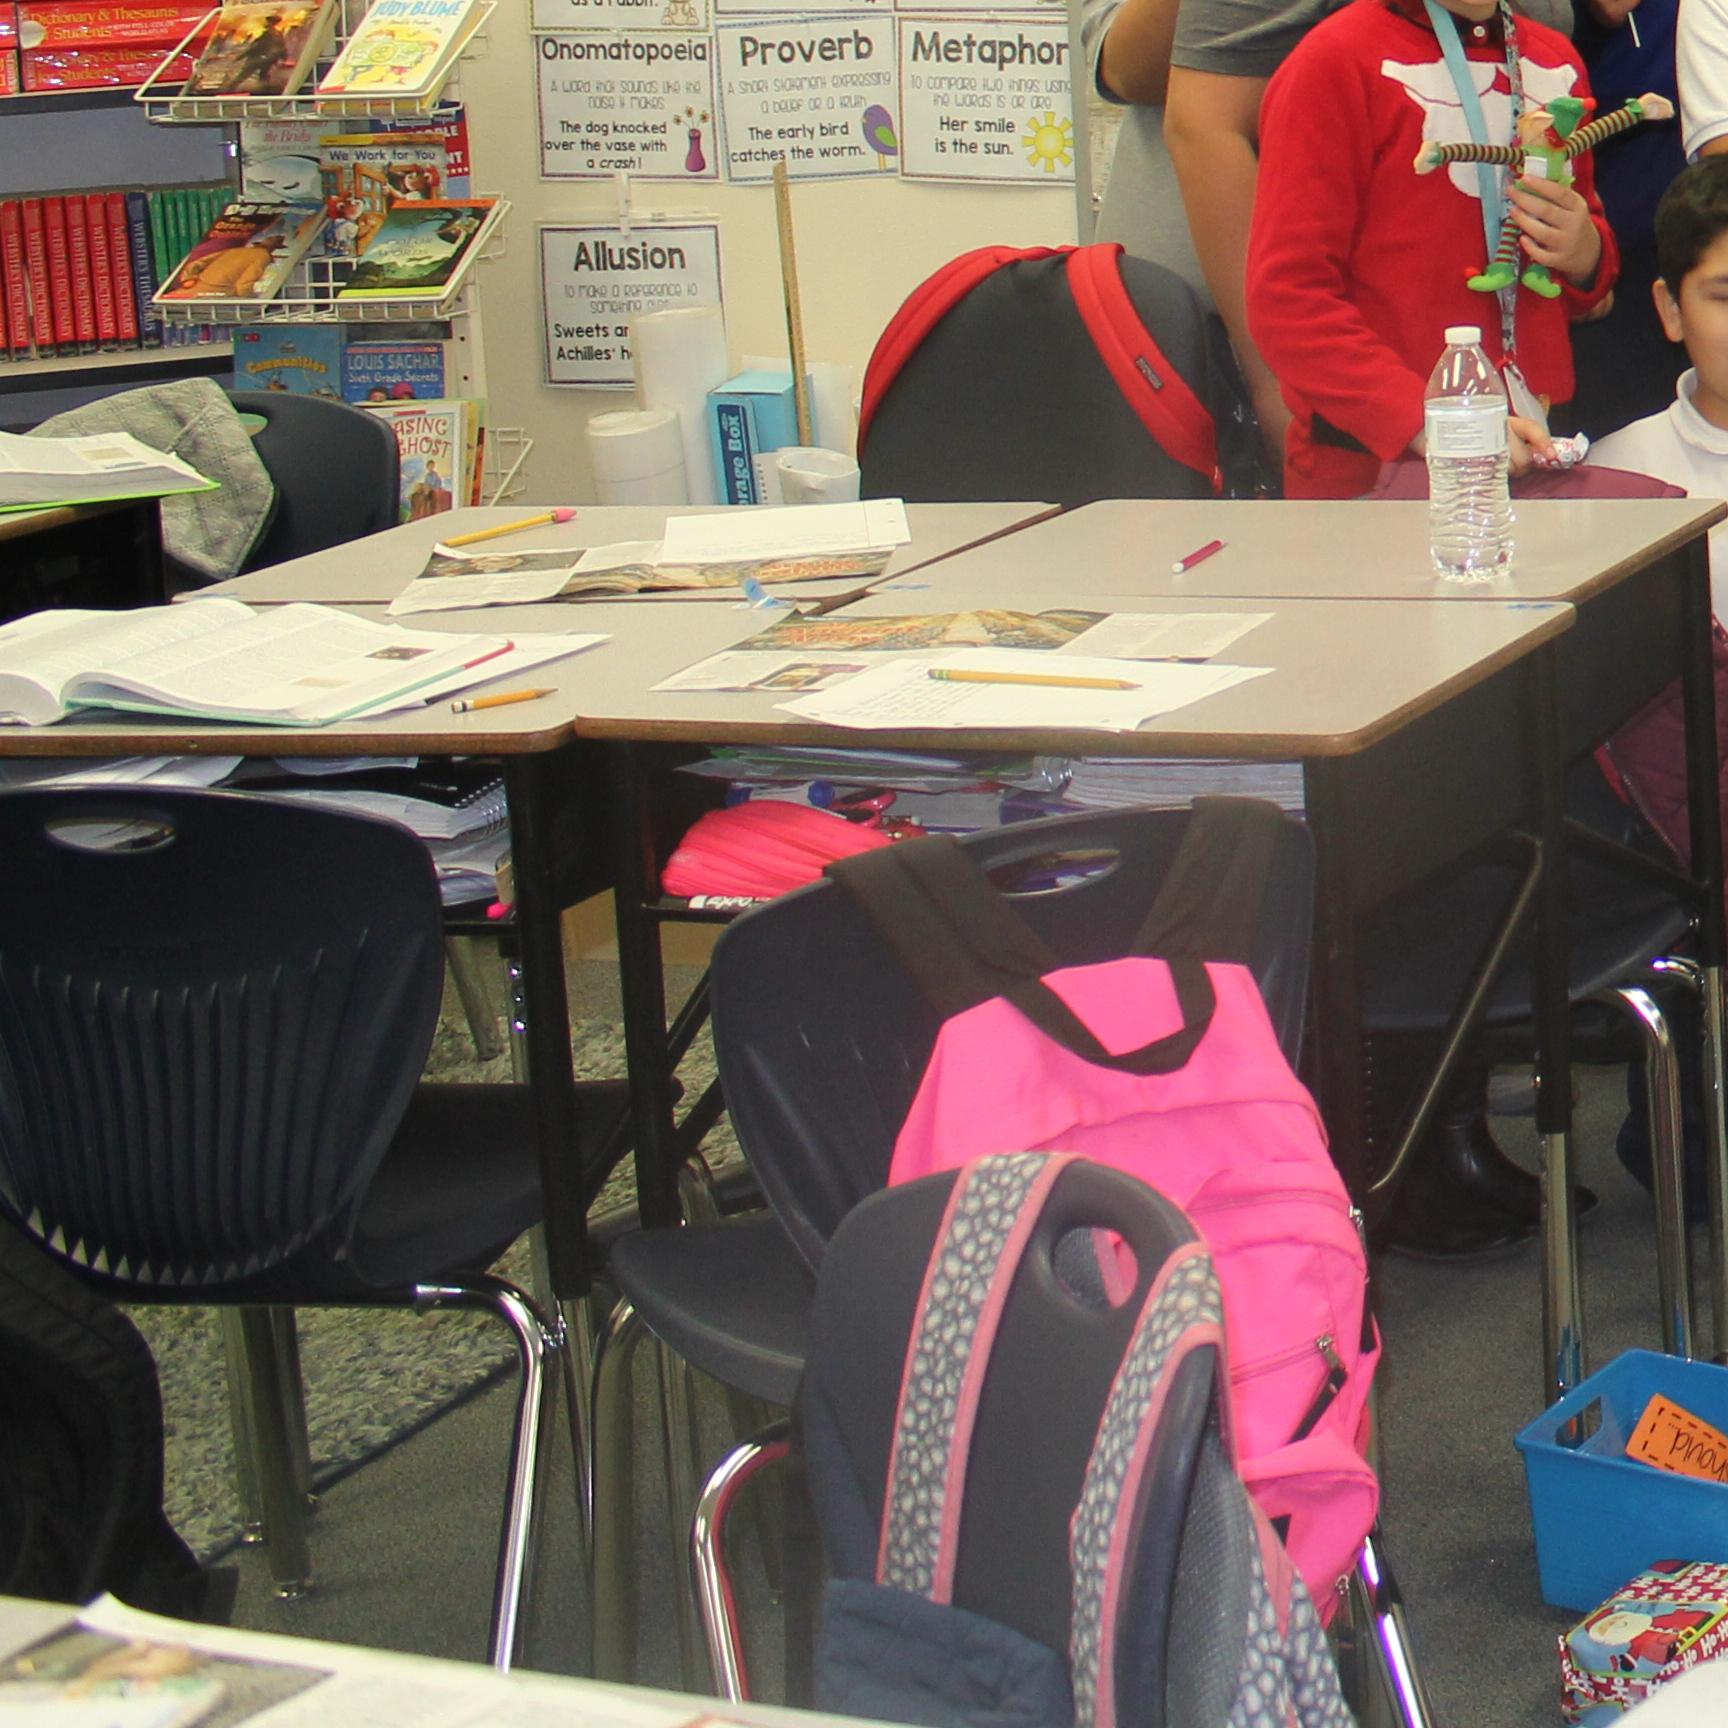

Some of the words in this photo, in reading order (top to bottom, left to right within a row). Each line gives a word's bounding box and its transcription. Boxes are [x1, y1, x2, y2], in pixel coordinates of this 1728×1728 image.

[374, 0, 409, 16] JUDY
[410, 0, 463, 16] BLUME
[54, 26, 112, 39] Students
[541, 36, 707, 64] Onomatopoeia
[740, 30, 872, 66] Proverb
[911, 31, 1067, 66] Metaphor
[612, 122, 666, 134] knocked
[329, 150, 348, 161] We
[355, 150, 386, 161] Work
[392, 150, 408, 160] for
[414, 150, 436, 161] You
[573, 241, 685, 271] Allusion
[554, 323, 610, 339] Sweets
[556, 344, 616, 361] Achilles'
[348, 355, 383, 370] LOUIS
[388, 355, 439, 369] SACHAR
[729, 415, 742, 451] Box
